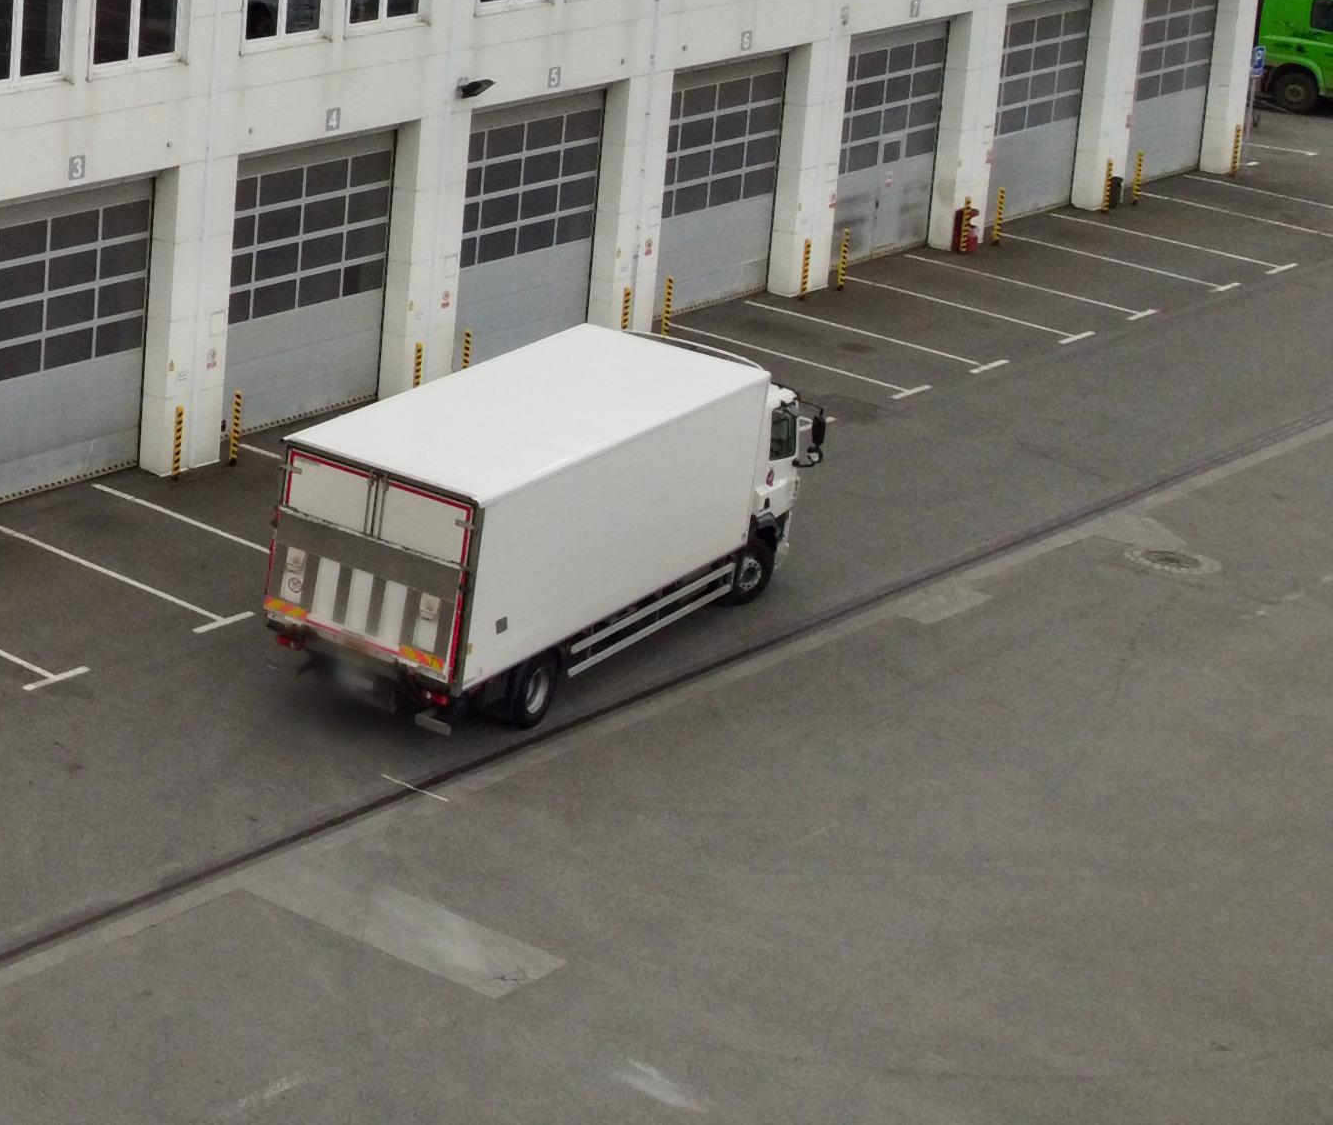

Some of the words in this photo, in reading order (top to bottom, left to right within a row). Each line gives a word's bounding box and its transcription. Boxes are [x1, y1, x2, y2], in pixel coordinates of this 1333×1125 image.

[550, 68, 558, 86] 5
[328, 110, 338, 128] 4
[73, 157, 82, 178] 3
